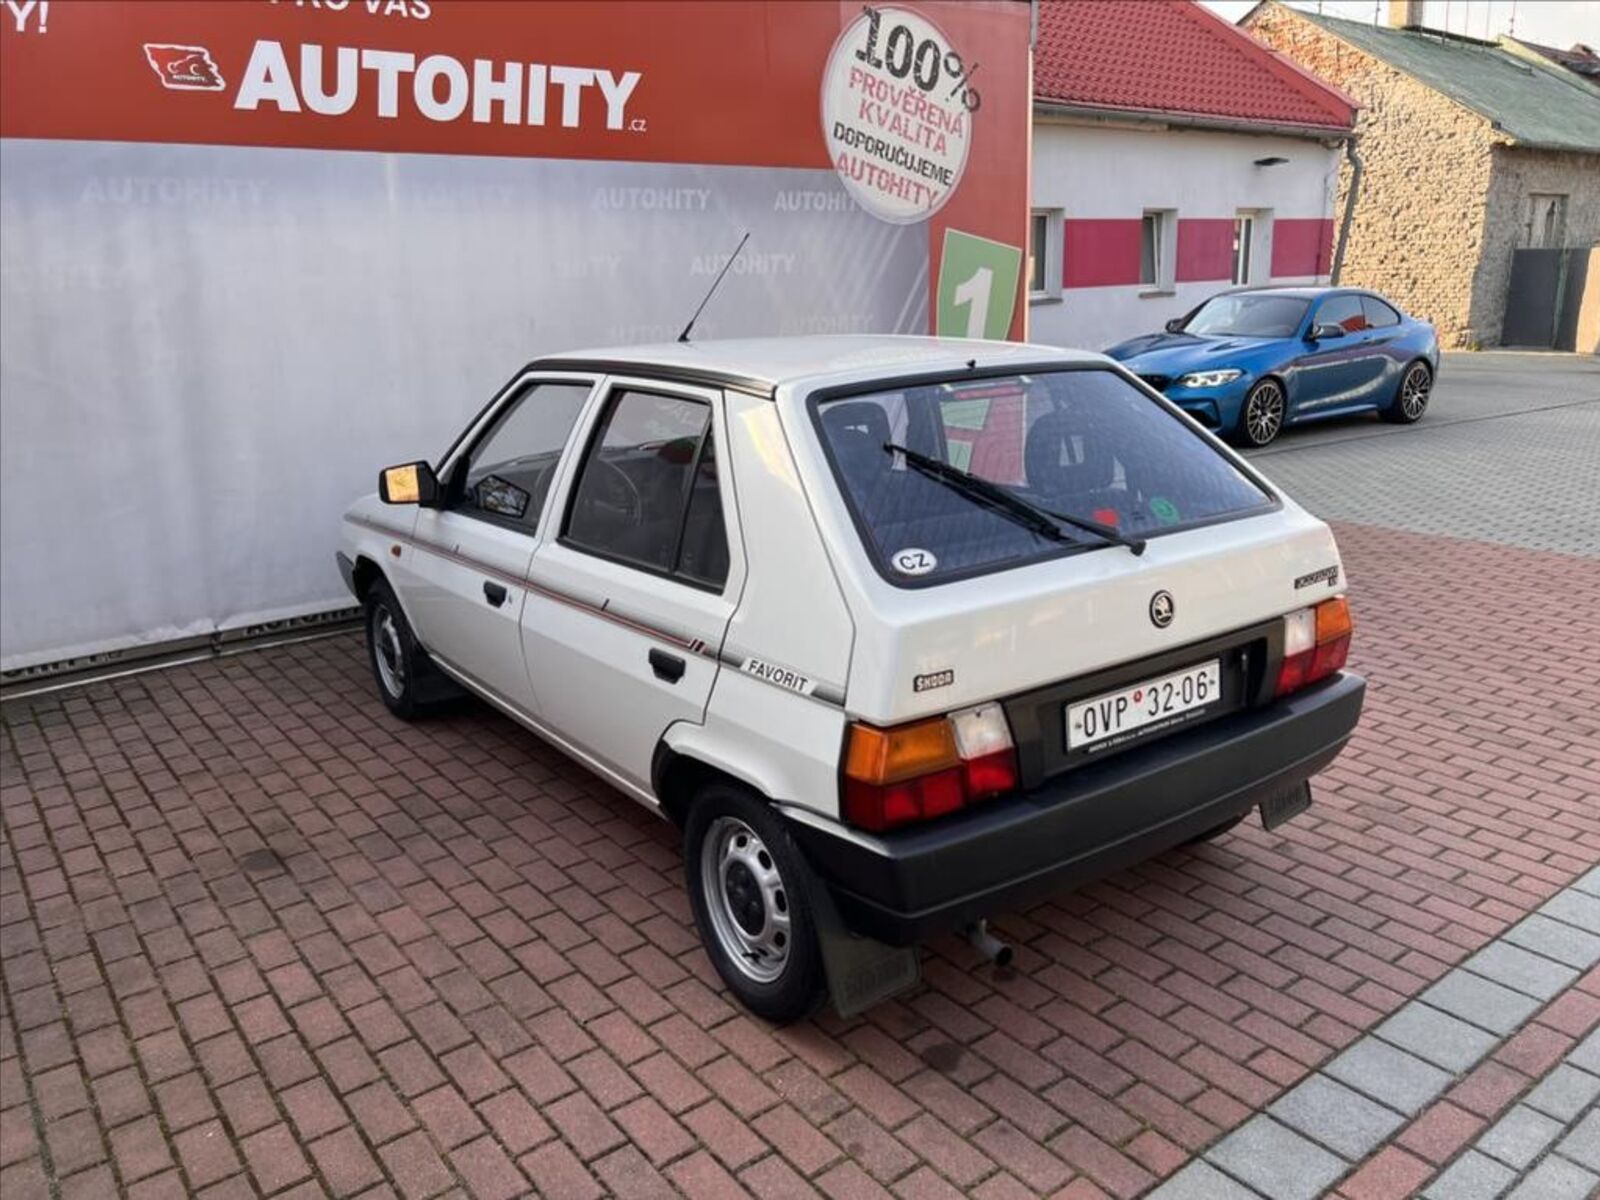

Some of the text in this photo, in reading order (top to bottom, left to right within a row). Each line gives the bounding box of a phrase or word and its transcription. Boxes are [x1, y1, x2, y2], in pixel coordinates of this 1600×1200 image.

[0, 0, 48, 33] Y!
[856, 6, 981, 113] 100%
[833, 121, 954, 187] DOPORUČUJEME
[859, 99, 947, 156] KVALITA
[594, 186, 712, 212] AUTOHITY
[836, 151, 939, 210] AUTOHITY
[689, 252, 796, 277] AUTOHITY
[953, 266, 993, 340] 1
[898, 552, 931, 571] CZ
[748, 659, 809, 691] FAVORIT
[1083, 696, 1129, 737] OVP
[1148, 671, 1208, 716] 32-06
